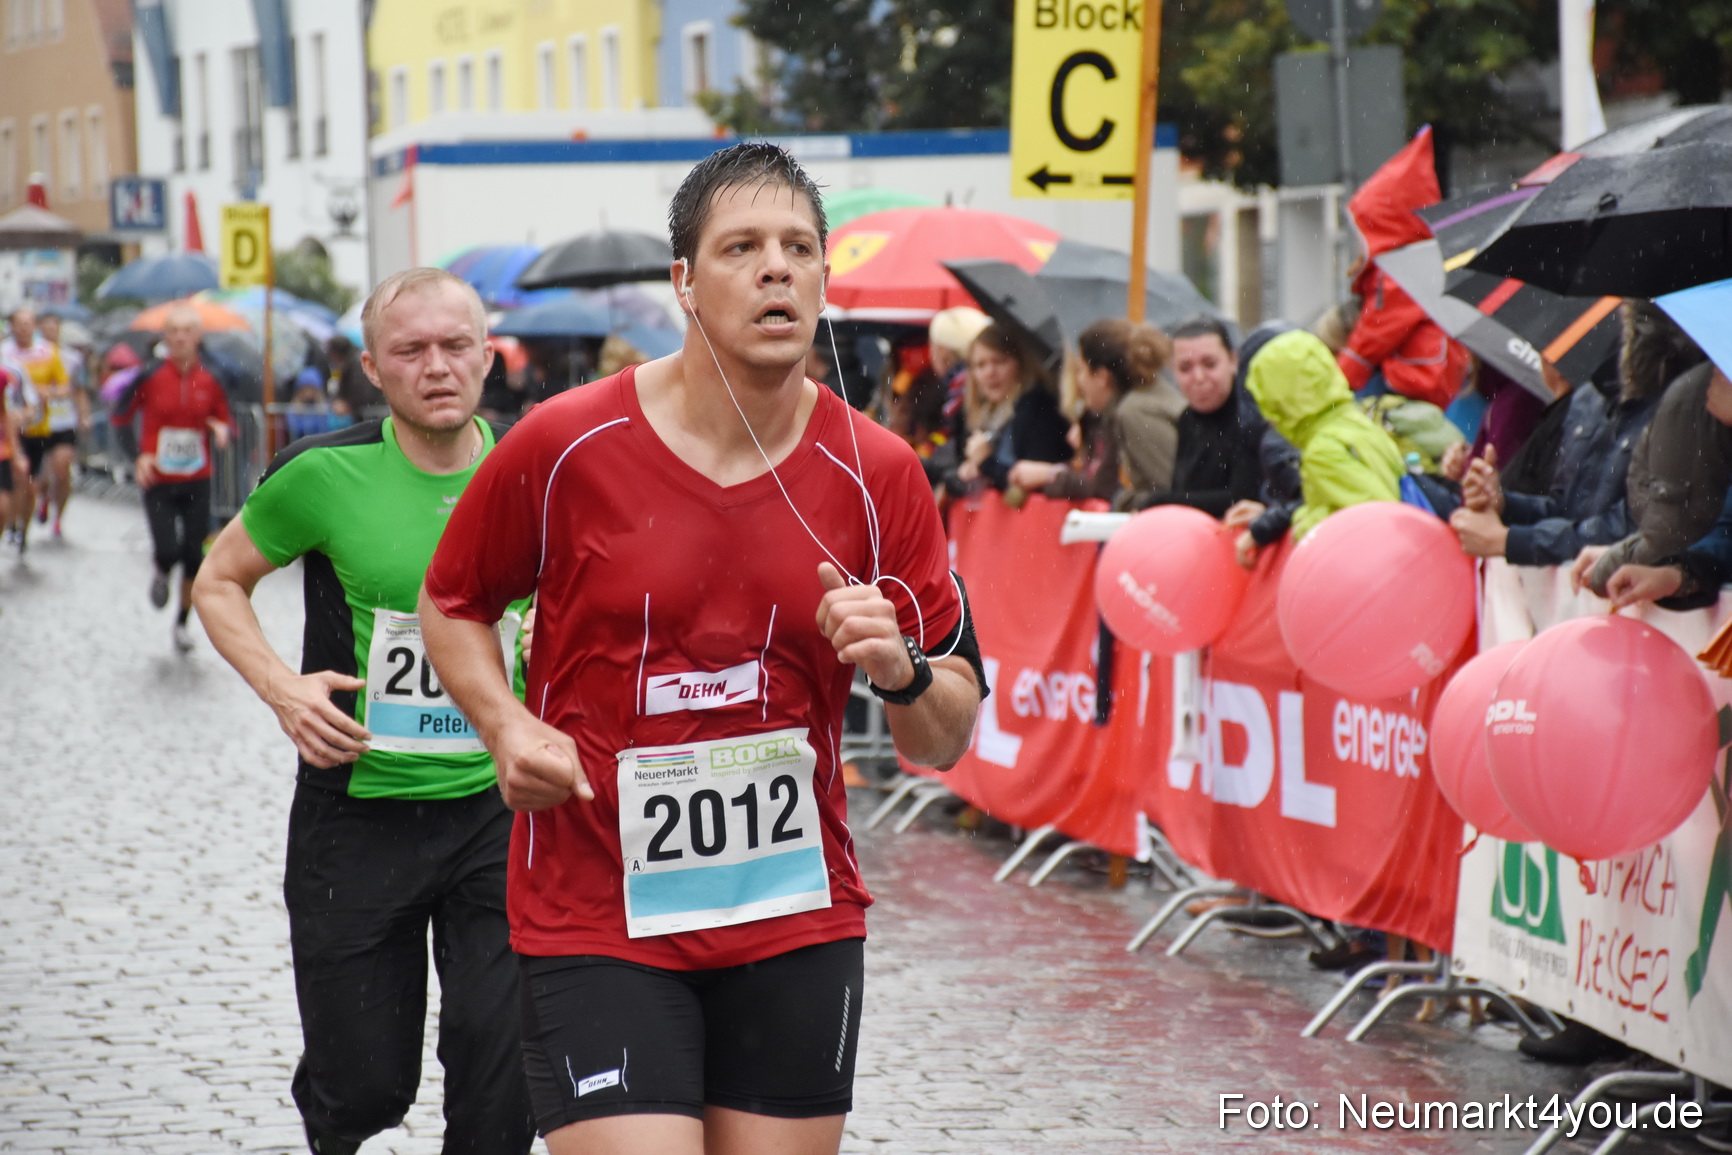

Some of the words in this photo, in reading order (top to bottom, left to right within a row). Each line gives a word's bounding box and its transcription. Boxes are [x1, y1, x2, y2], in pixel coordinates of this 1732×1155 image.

[1034, 0, 1142, 31] Block
[1049, 50, 1118, 151] C
[233, 230, 258, 269] D
[678, 680, 728, 699] DEHN
[709, 737, 801, 770] BOCK
[634, 765, 699, 781] NeuerMarkt
[711, 769, 741, 778] inspired
[644, 775, 803, 862] 2012
[632, 860, 641, 872] A
